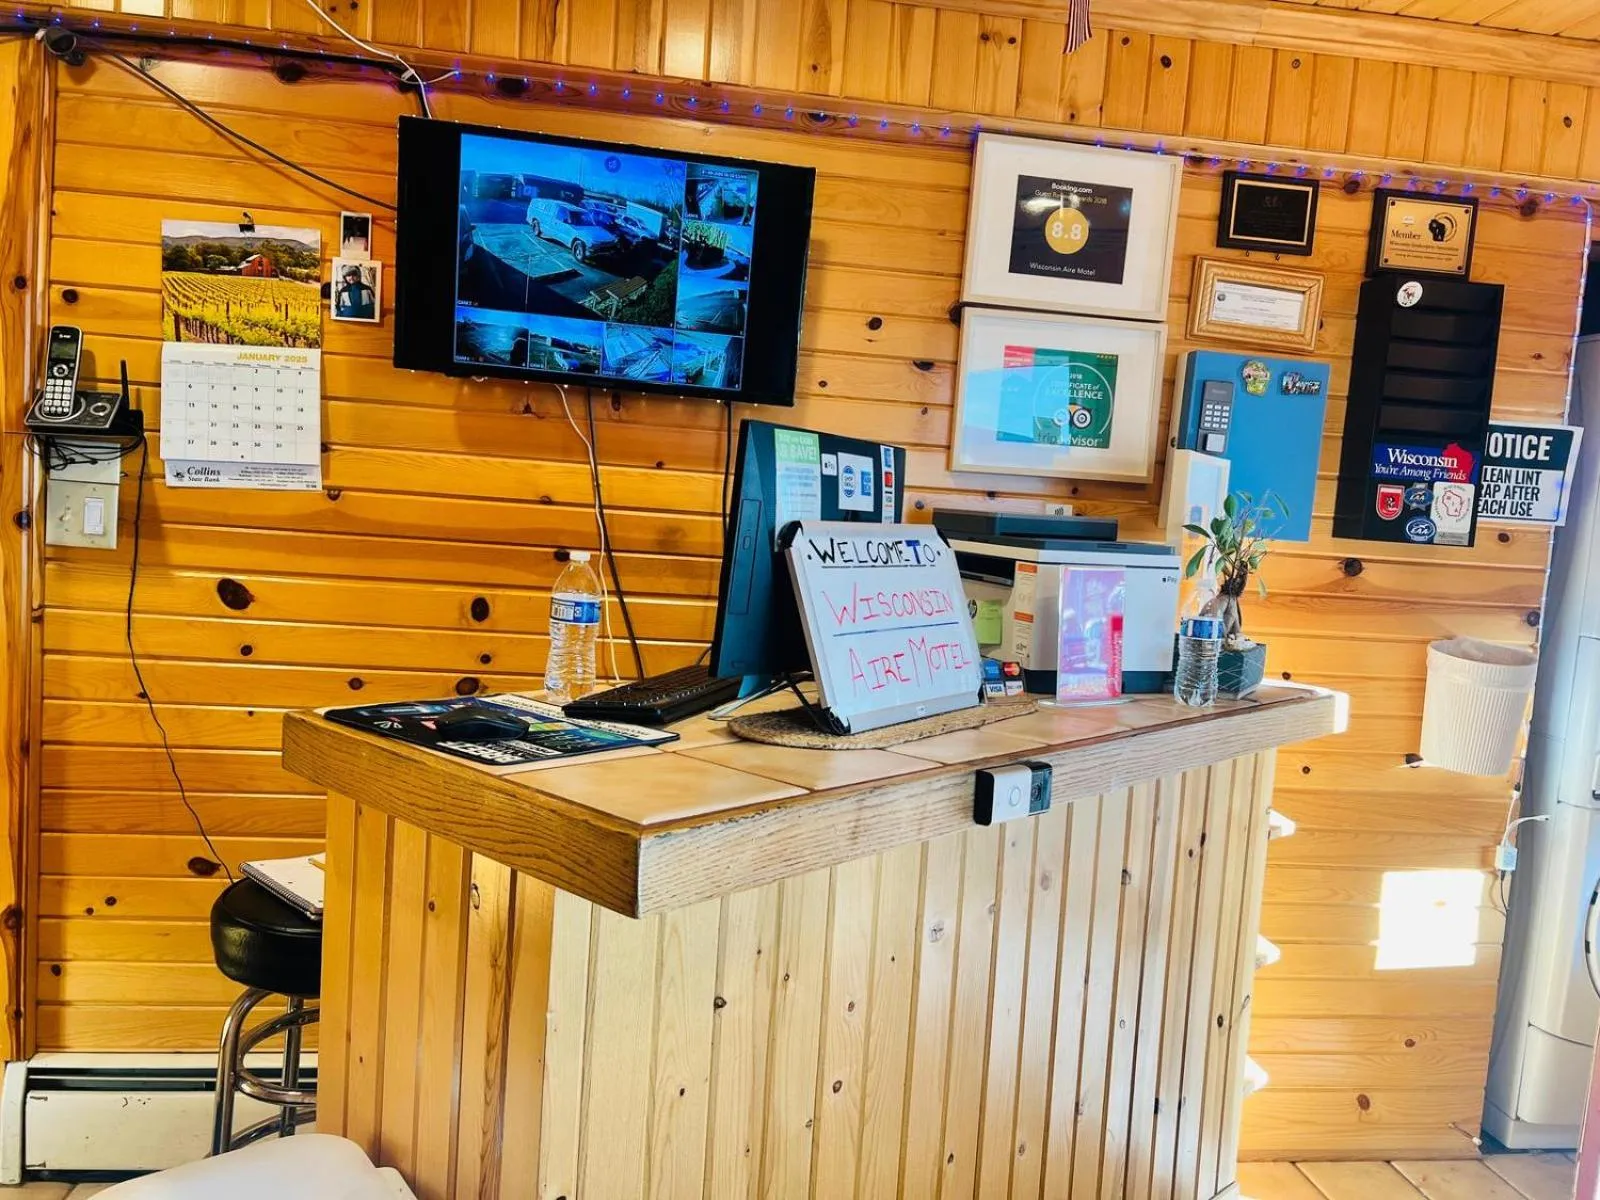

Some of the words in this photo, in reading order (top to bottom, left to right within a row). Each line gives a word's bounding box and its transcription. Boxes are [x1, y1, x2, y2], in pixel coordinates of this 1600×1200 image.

[1051, 182, 1093, 194] Booking.com
[1052, 221, 1081, 240] 8.8
[1391, 229, 1422, 240] Member
[1029, 261, 1062, 272] Wisconsin
[1076, 267, 1096, 276] Motel
[236, 351, 281, 363] JANUARY
[1485, 431, 1553, 461] OTICE
[1387, 448, 1459, 468] Wisconsin
[187, 466, 221, 477] Collins
[1375, 463, 1396, 474] You're
[1400, 466, 1431, 480] Among
[1433, 468, 1466, 480] Friends
[1483, 467, 1512, 484] LEAN
[1515, 469, 1543, 485] LINT
[1503, 484, 1540, 502] AFTER
[1509, 500, 1534, 516] USE
[809, 537, 911, 564] WELCOME
[822, 582, 954, 627] WISCONSIN
[848, 647, 911, 697] AIRE
[908, 635, 973, 687] MOTEL
[989, 685, 1003, 693] VISA
